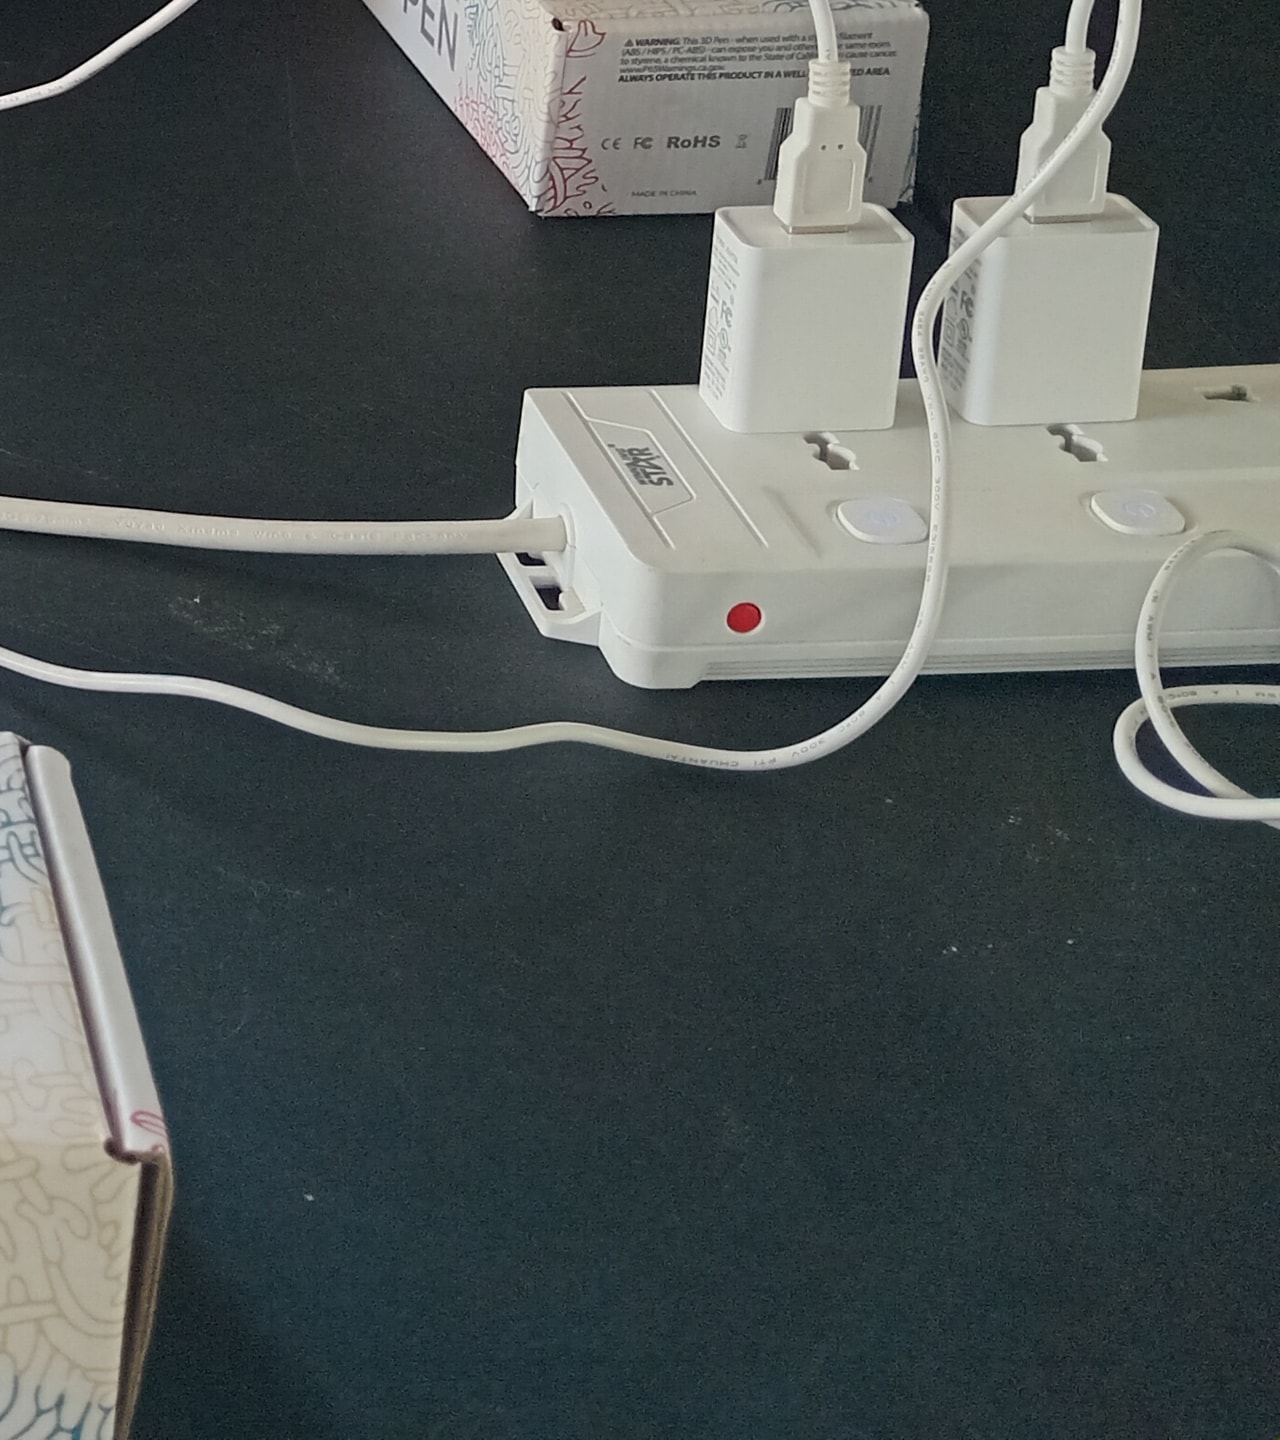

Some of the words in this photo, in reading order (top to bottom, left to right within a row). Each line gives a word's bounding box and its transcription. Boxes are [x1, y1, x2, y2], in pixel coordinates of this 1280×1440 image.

[764, 51, 785, 61] State
[618, 73, 654, 83] ALWAYS
[655, 72, 695, 81] OPERATE
[696, 71, 718, 80] THIS
[719, 70, 762, 80] PRODUCT
[666, 135, 721, 149] RoHS
[631, 190, 656, 198] MADE
[670, 189, 697, 197] CHINA
[626, 447, 674, 486] STAR
